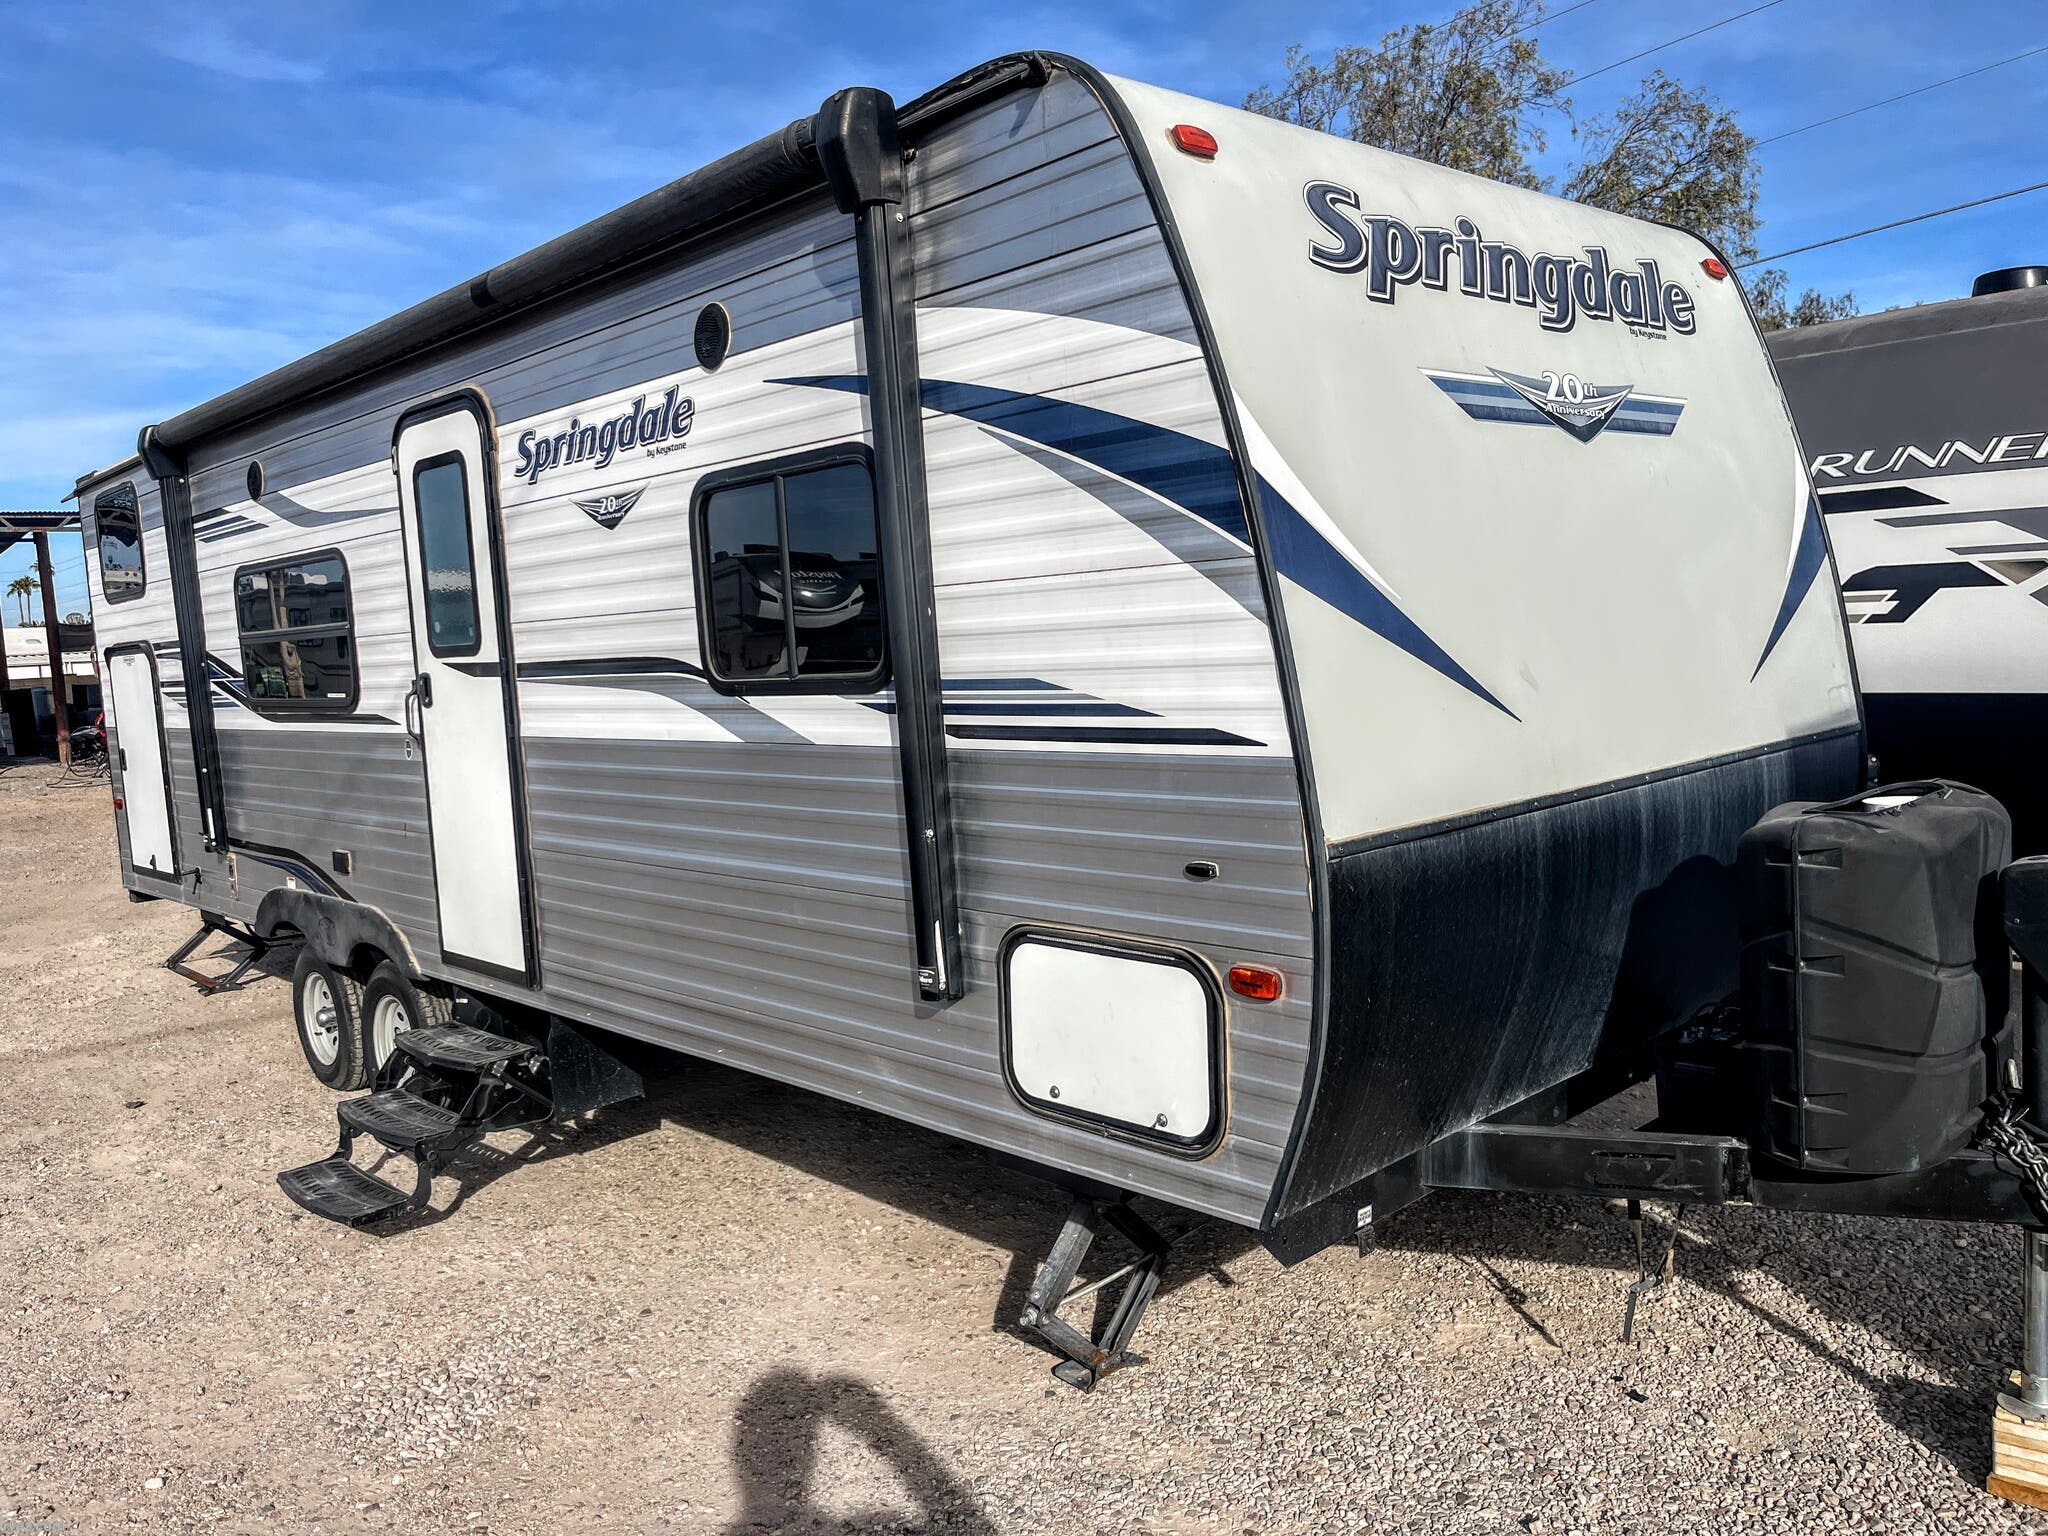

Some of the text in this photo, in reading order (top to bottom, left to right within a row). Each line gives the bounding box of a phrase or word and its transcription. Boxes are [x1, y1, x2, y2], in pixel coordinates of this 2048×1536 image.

[1303, 180, 1696, 334] Springdale
[1638, 328, 1668, 341] Keystone
[1541, 370, 1599, 405] 20th
[1545, 403, 1606, 420] Anniversary
[514, 384, 695, 485] Springdale
[646, 442, 687, 459] by Keystone
[1810, 432, 2048, 478] RUNNE
